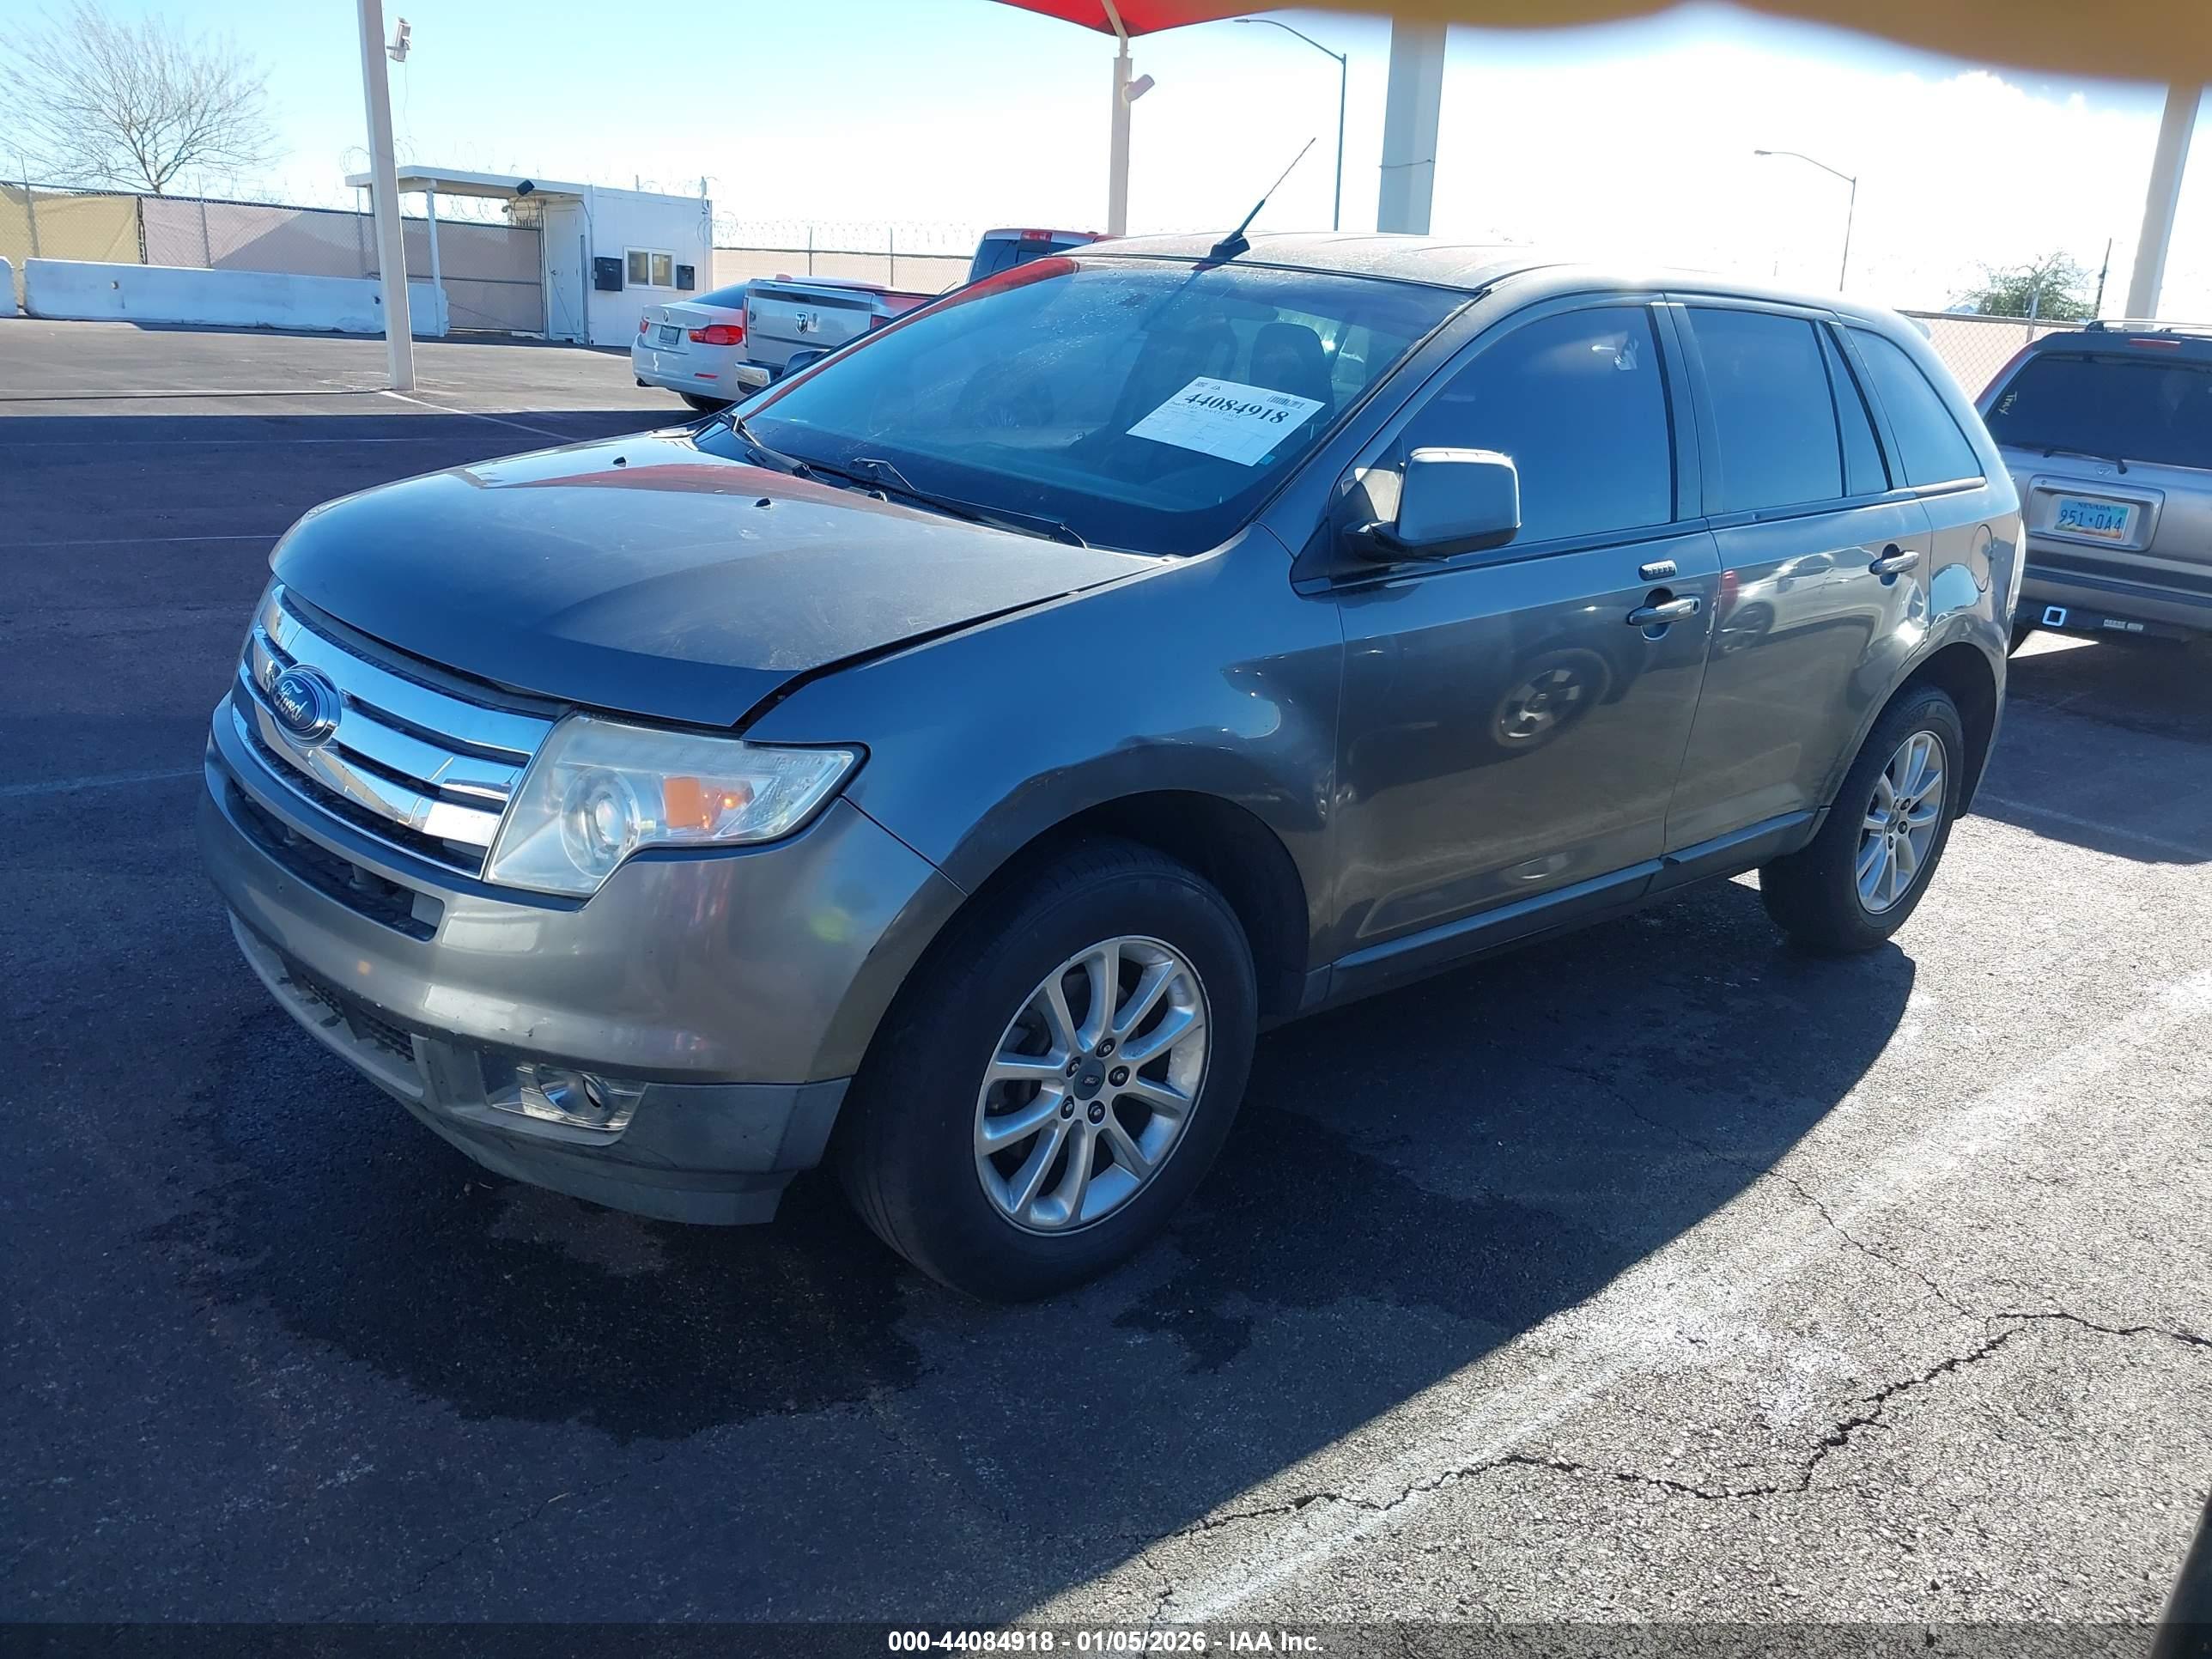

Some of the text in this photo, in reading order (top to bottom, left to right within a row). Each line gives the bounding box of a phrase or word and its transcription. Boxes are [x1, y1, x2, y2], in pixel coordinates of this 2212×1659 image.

[1184, 392, 1290, 424] 44084918
[2075, 501, 2112, 513] NEVADA
[275, 679, 308, 721] Ford
